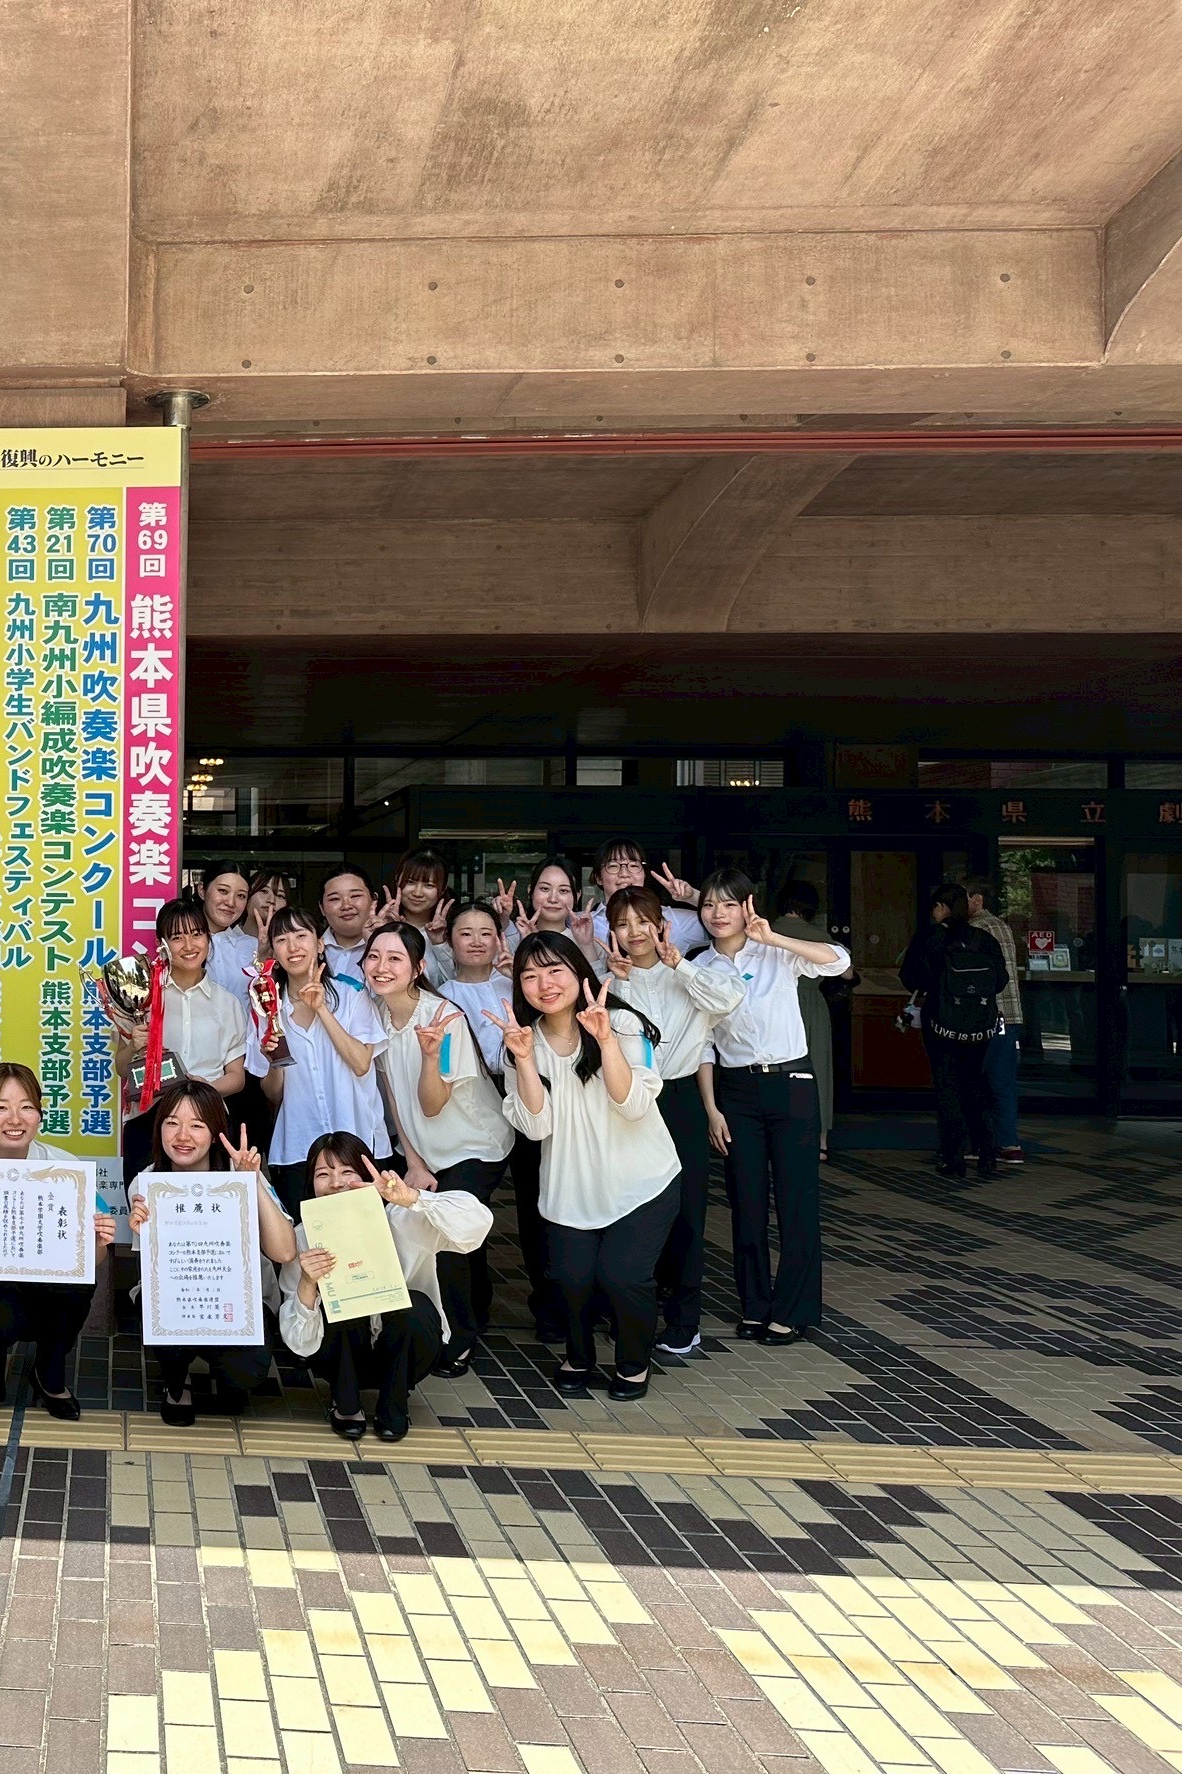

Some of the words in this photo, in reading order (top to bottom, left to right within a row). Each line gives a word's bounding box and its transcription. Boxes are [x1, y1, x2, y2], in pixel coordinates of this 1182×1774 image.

[1, 448, 145, 468] 復興のハーモニー
[6, 506, 38, 582] 第43回
[46, 506, 77, 581] 第21回
[86, 506, 118, 581] 第70回
[137, 501, 168, 578] 第69回
[1, 592, 36, 969] 九州小学生バンドフェスティバル
[39, 592, 79, 971] 南九州小編成吹奏楽コンテスト
[78, 592, 120, 968] 九州吹奏楽コンクール
[128, 593, 174, 956] 熊本県吹奏楽コ
[39, 980, 72, 1135] 熊本支部予選
[934, 1023, 957, 1040] LIVE
[57, 1205, 68, 1240] 表彰状
[175, 1203, 221, 1213] 推薦状
